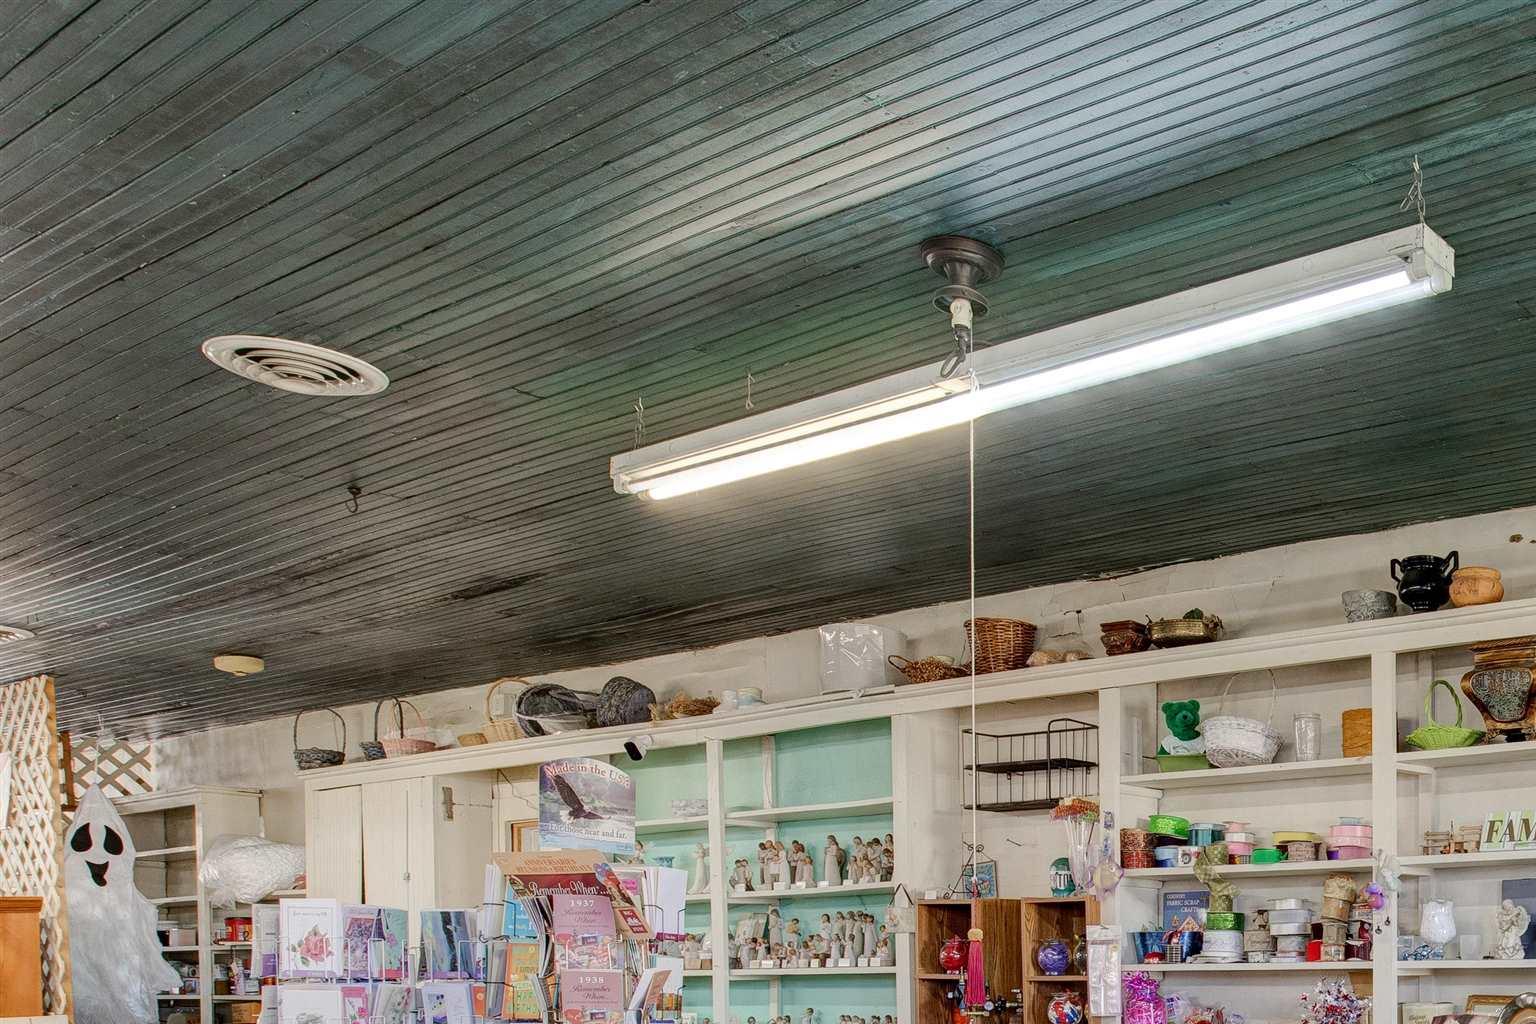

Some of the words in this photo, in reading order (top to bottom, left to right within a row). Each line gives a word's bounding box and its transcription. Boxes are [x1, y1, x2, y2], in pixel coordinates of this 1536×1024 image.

[544, 761, 576, 777] Made
[577, 762, 587, 772] in
[590, 764, 607, 777] the
[609, 770, 631, 789] USA
[602, 829, 614, 838] and
[529, 881, 571, 897] Remember
